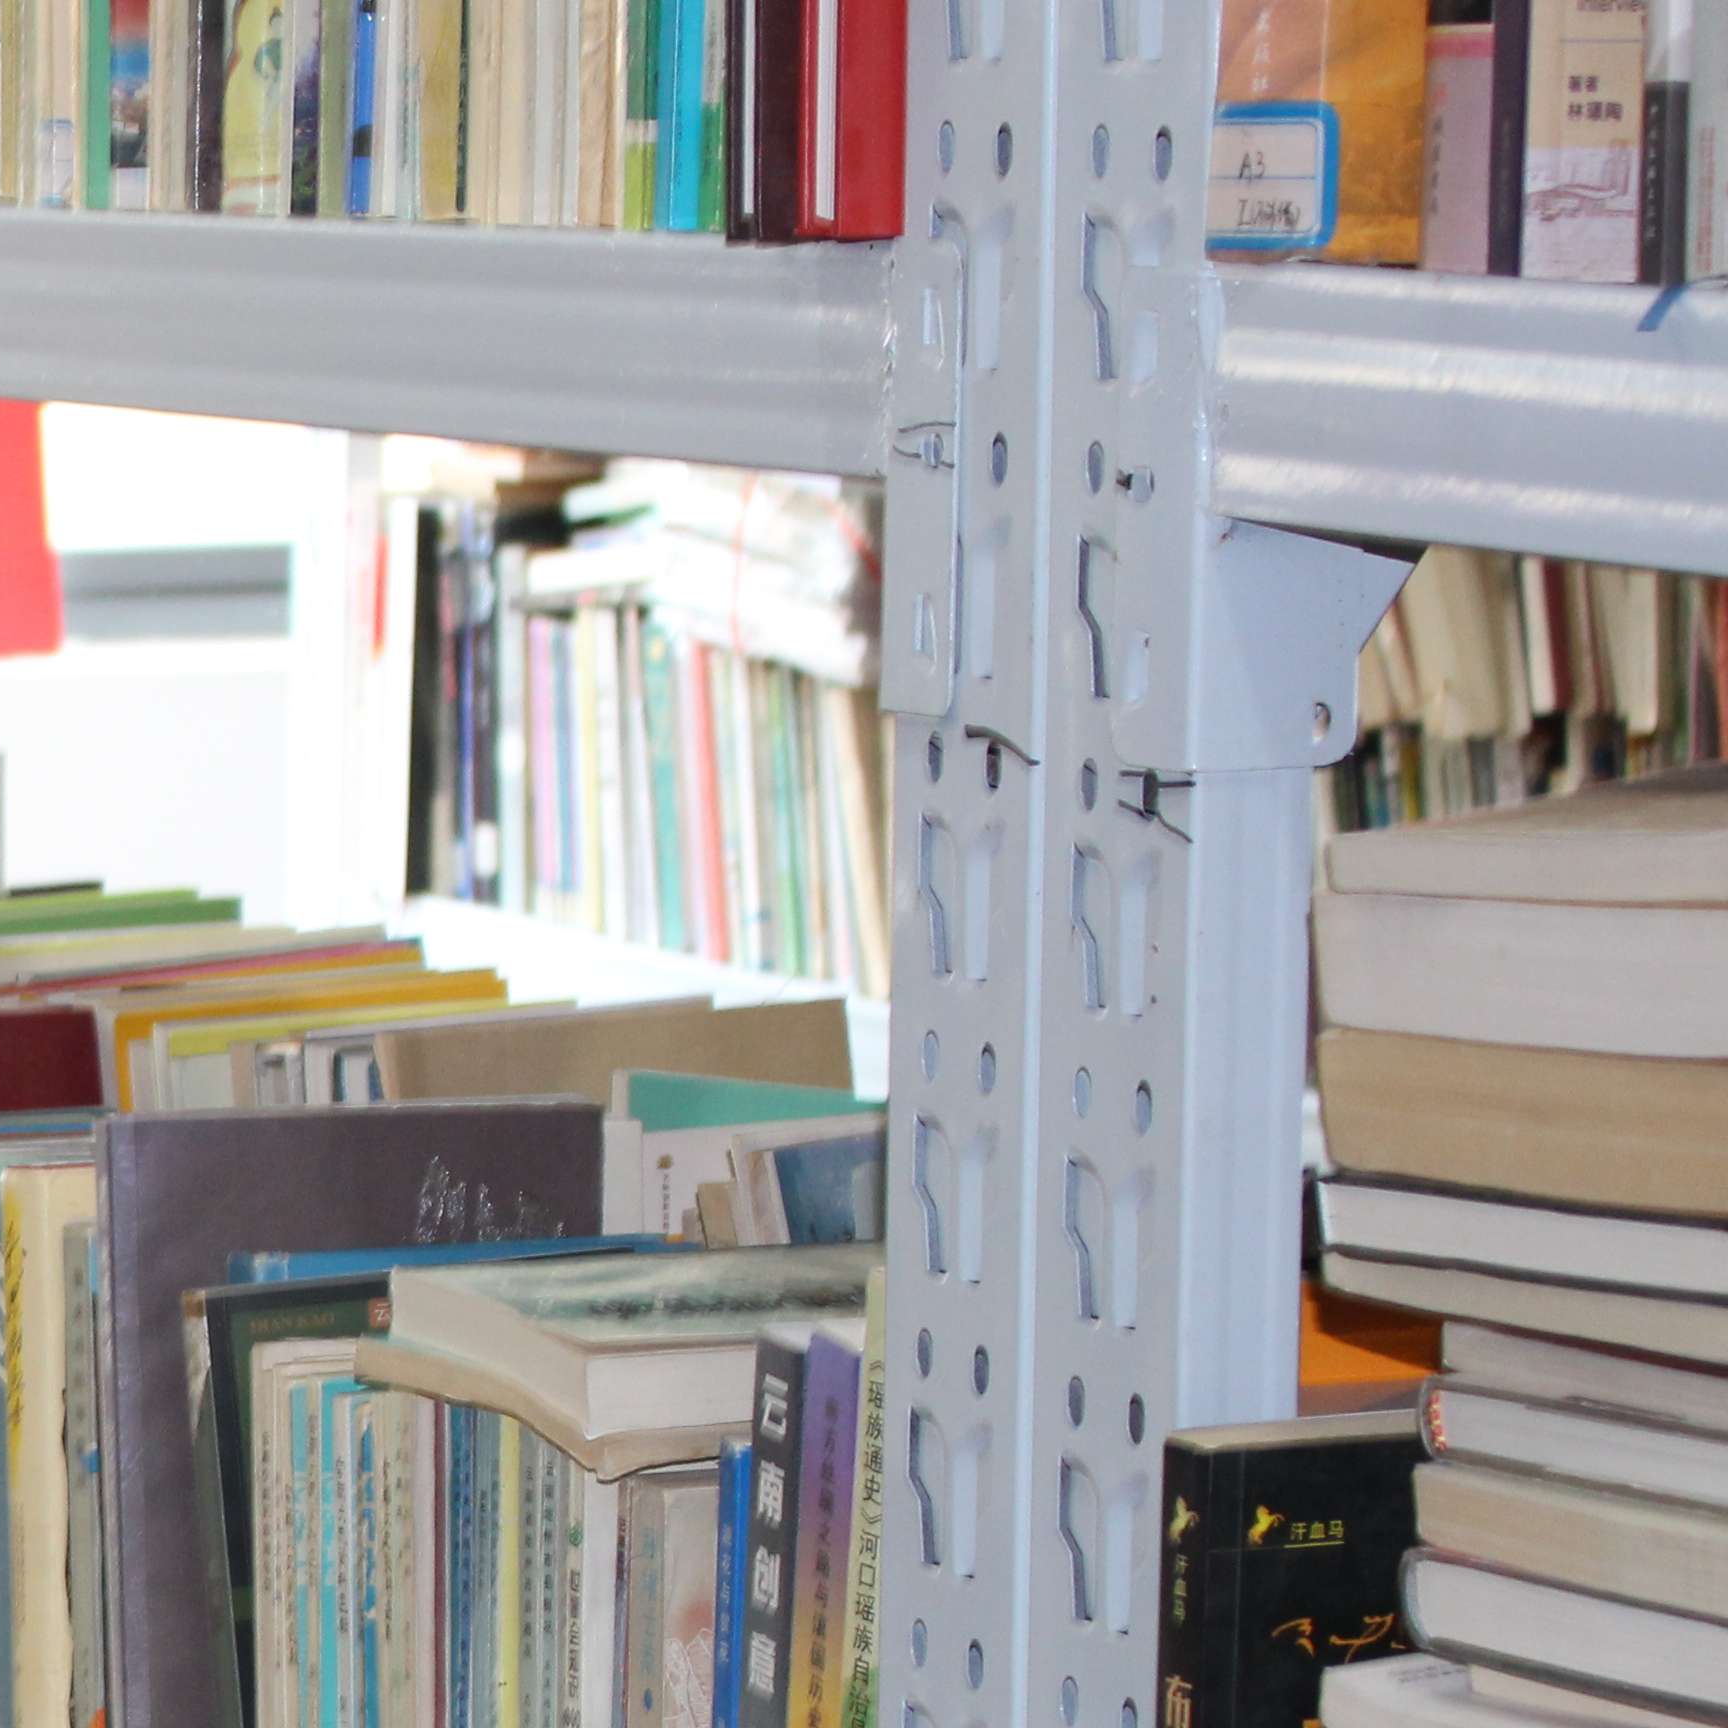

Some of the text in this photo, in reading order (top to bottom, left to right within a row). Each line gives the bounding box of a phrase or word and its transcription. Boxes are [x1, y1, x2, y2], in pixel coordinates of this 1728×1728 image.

[748, 1372, 790, 1697] 云南创意
[1290, 1519, 1345, 1542] 汗血马
[1173, 1553, 1190, 1623] 汗血马
